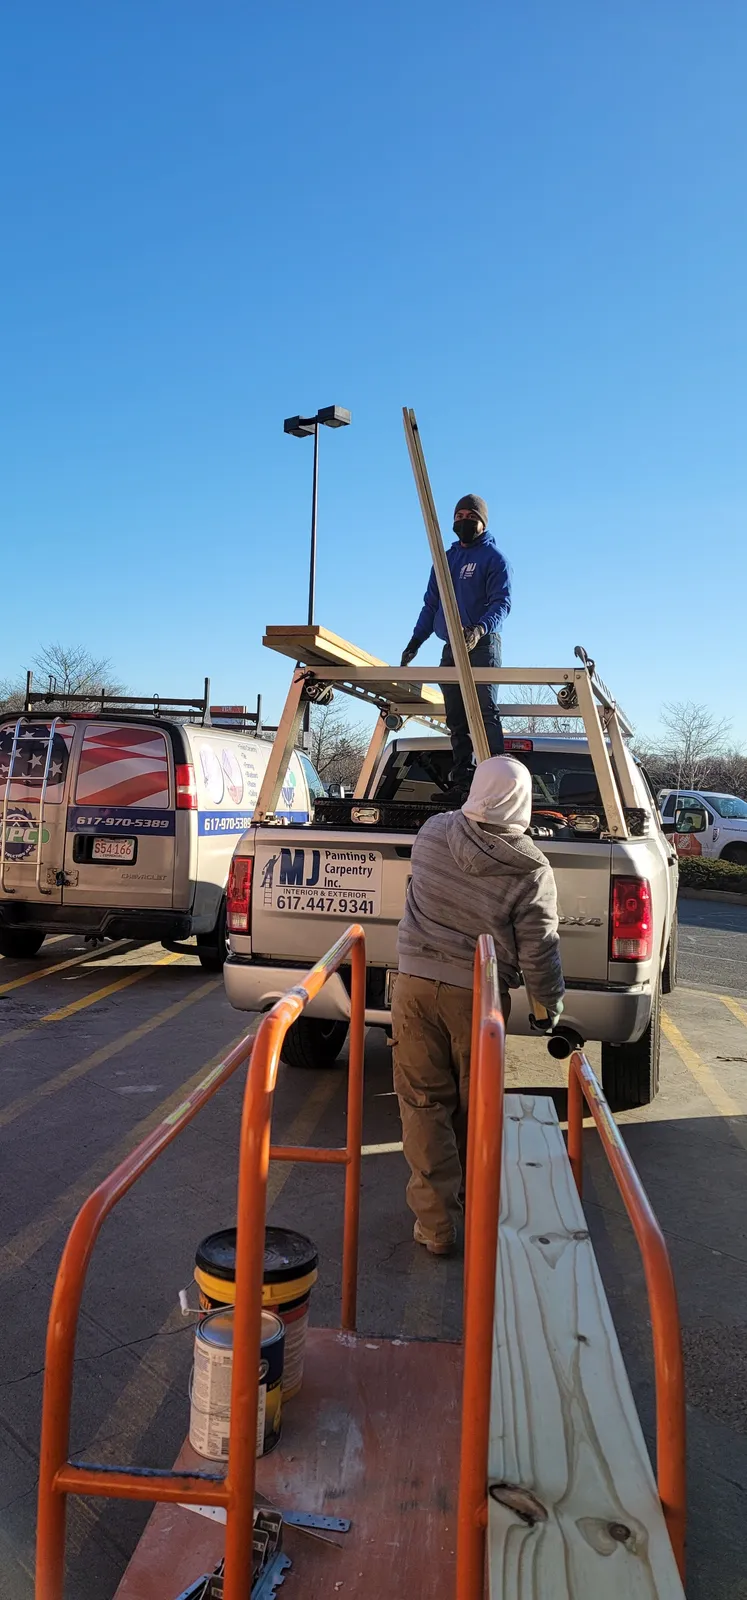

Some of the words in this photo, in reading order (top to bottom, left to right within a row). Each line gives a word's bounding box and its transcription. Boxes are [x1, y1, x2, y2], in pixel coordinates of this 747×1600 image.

[76, 816, 170, 828] 617-970-5389
[204, 817, 252, 831] 617-970-5389
[325, 850, 366, 864] Painting
[368, 852, 377, 862] &
[279, 847, 321, 887] MJ
[324, 863, 373, 878] Carpentry
[324, 877, 341, 888] Inc.
[283, 888, 319, 896] INTERIOR
[327, 891, 367, 899] EXTERIOR
[276, 895, 374, 915] 617.447.9341
